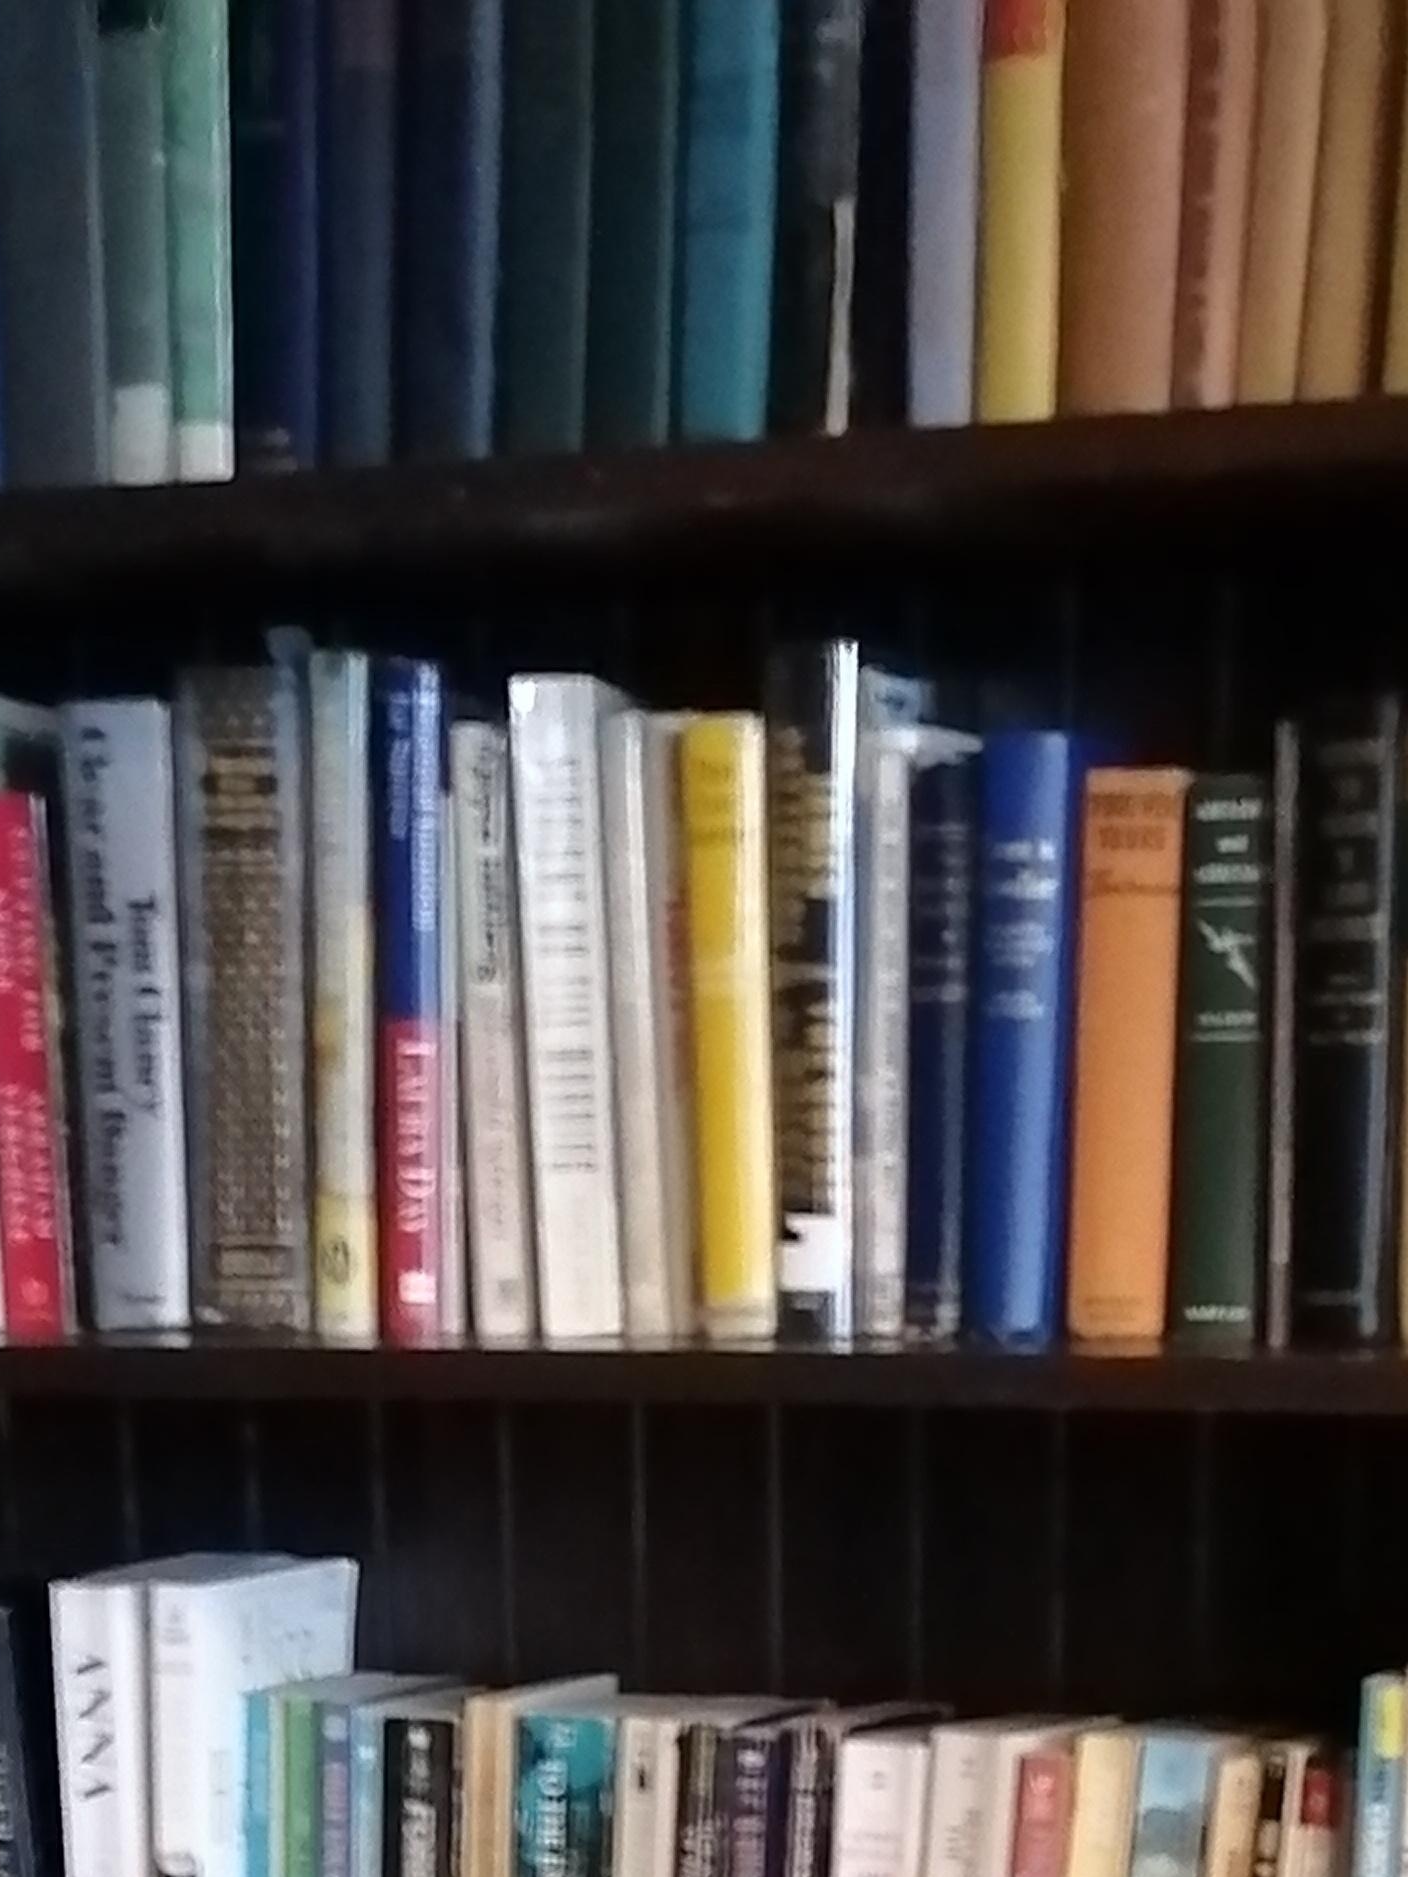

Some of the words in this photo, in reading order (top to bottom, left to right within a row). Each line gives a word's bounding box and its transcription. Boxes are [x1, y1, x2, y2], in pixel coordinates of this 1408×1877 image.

[80, 724, 111, 834] Clear
[86, 850, 109, 922] and
[127, 896, 155, 971] Tom
[88, 938, 119, 1095] Present
[132, 984, 169, 1117] Clancy
[97, 1111, 128, 1247] Danger
[75, 1653, 114, 1801] ANNA
[537, 1760, 568, 1797] TO
[535, 1798, 568, 1849] THE
